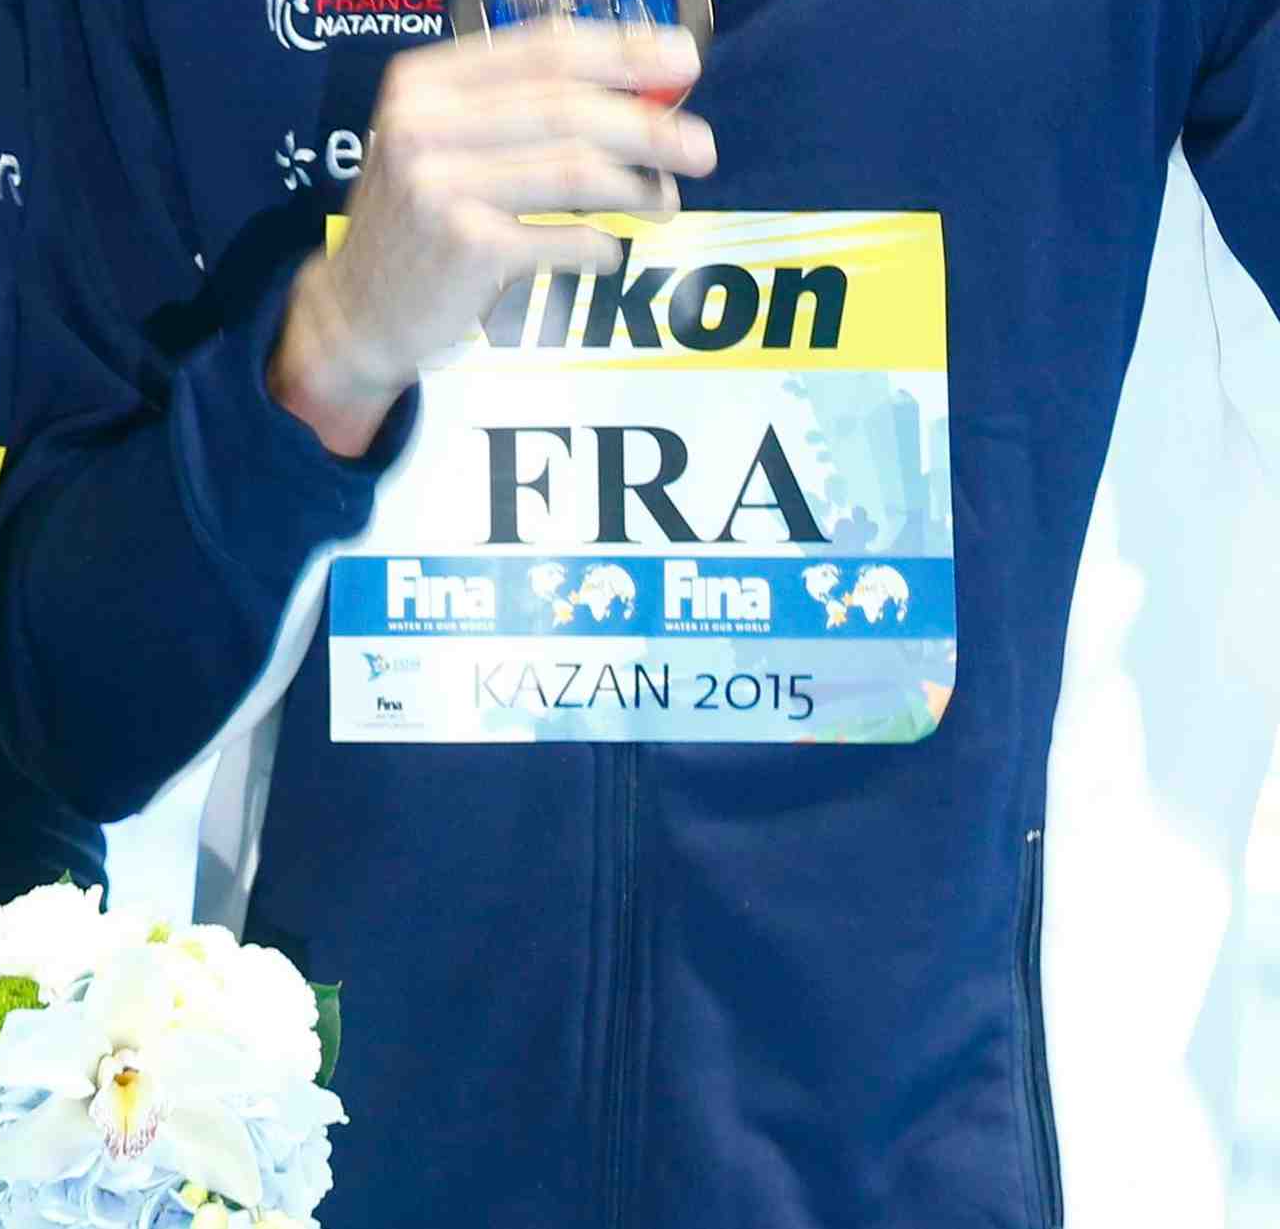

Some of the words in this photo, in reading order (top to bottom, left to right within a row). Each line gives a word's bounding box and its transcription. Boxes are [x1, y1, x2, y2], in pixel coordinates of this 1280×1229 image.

[314, 12, 443, 37] NATATION
[472, 423, 833, 545] FRA
[386, 559, 496, 619] Fina
[664, 559, 771, 620] Fina
[474, 662, 670, 710] KAZAN
[693, 673, 814, 721] 2015
